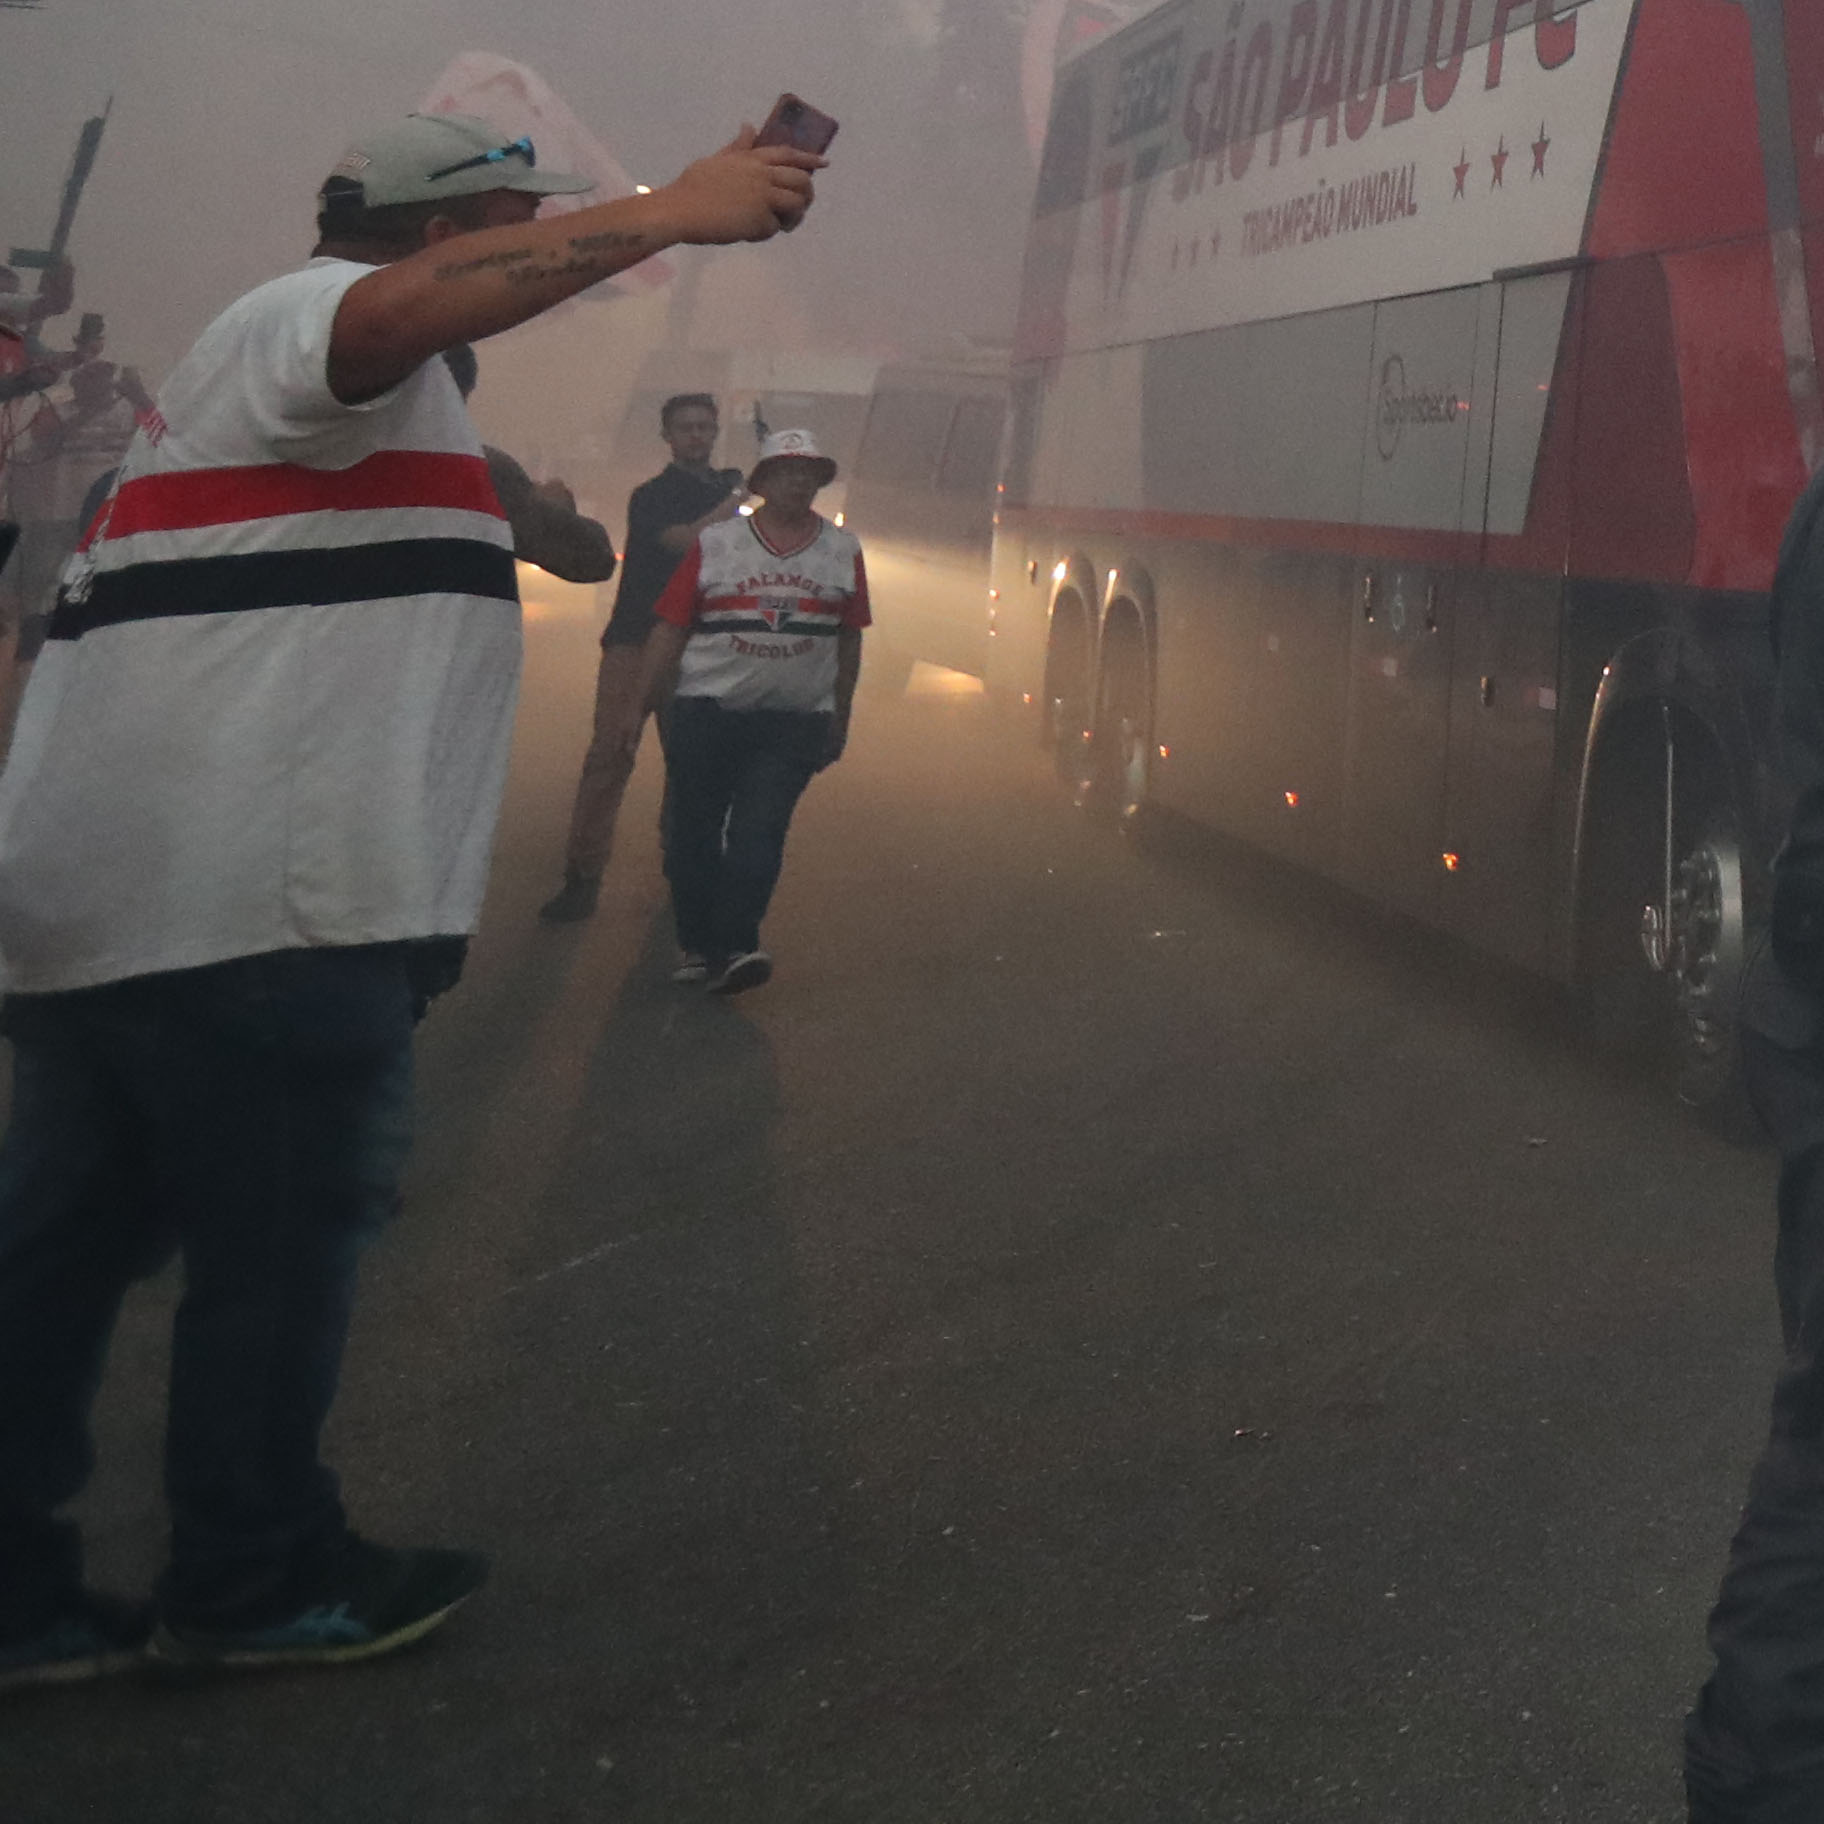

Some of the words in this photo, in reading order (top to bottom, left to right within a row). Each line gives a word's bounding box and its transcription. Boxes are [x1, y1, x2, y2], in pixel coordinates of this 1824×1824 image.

[1170, 1, 1273, 204] SÃO
[1241, 178, 1336, 257] TRICAMPEÃO
[1336, 161, 1418, 234] MUNDIAL
